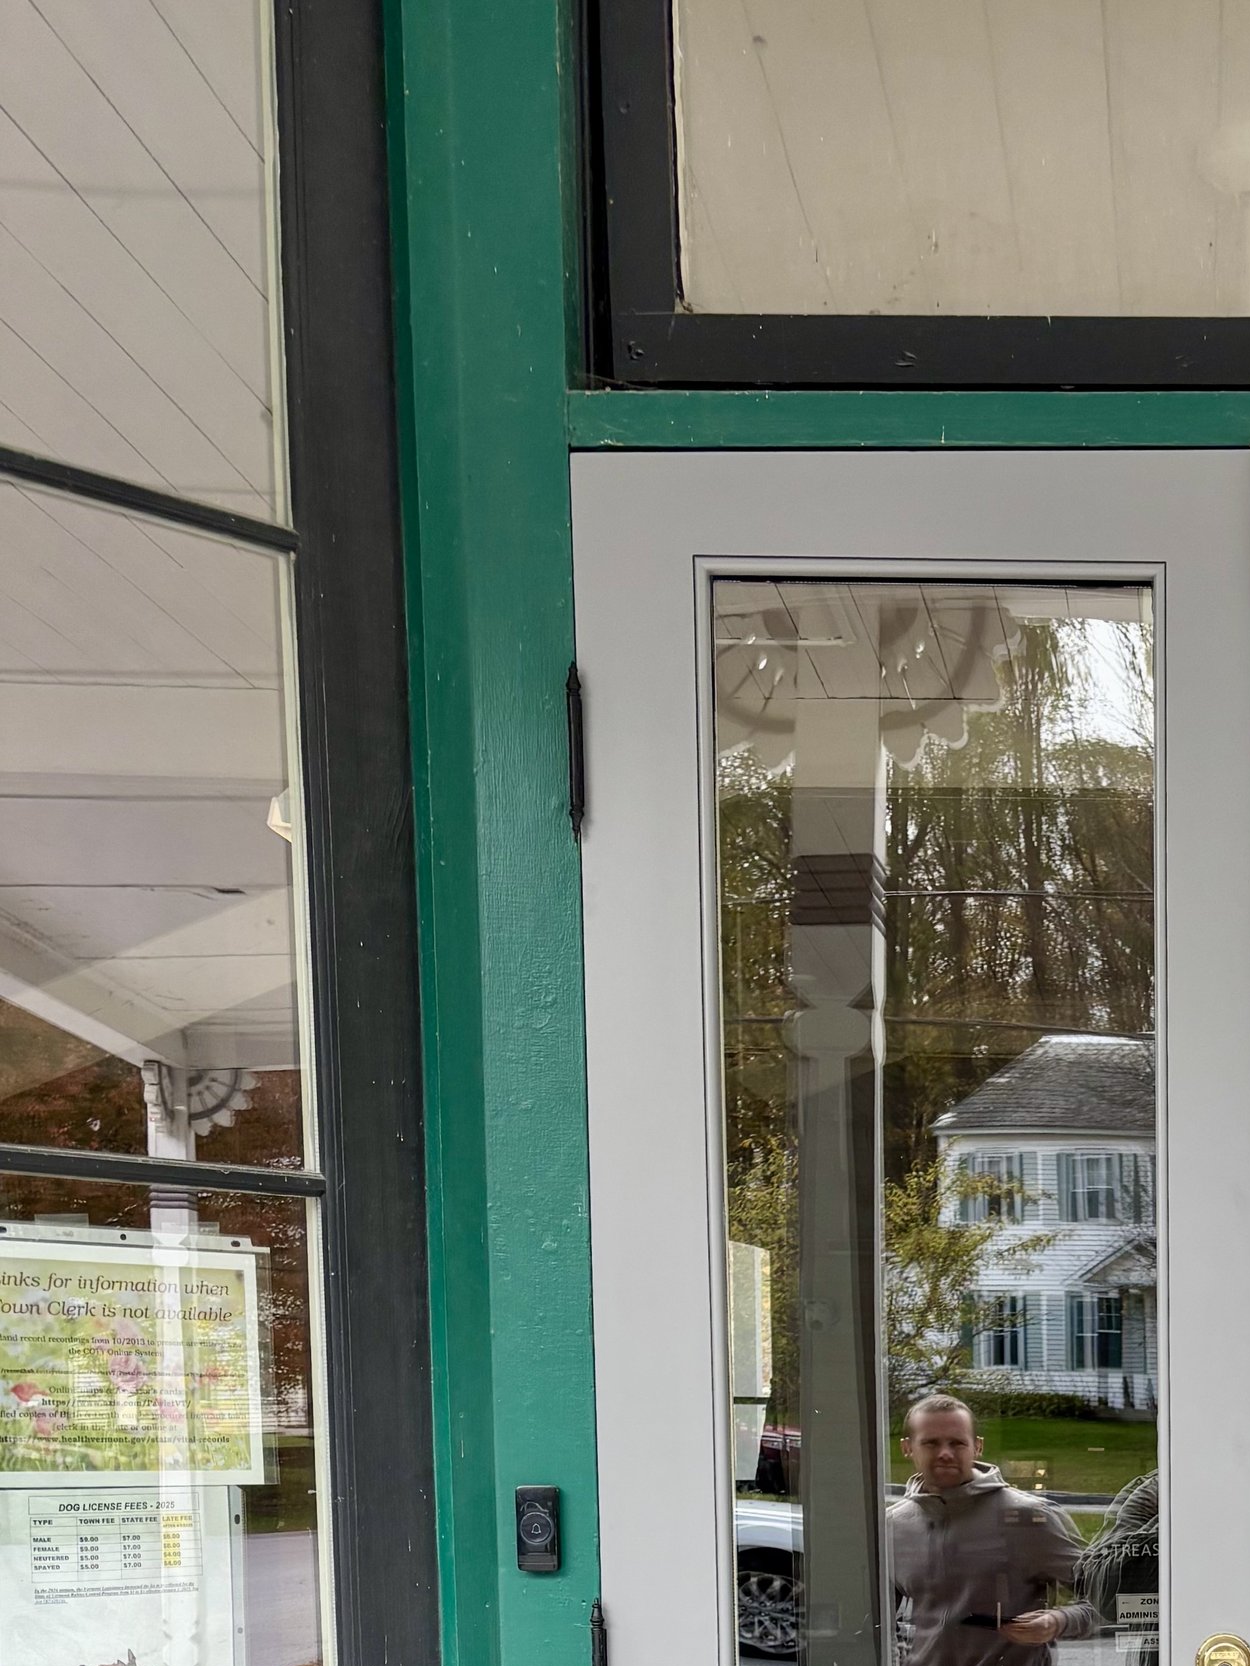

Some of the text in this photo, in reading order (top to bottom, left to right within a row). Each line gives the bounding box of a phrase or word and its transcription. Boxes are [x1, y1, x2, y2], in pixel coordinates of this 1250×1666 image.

[0, 1272, 230, 1296] inks for information when
[0, 1299, 233, 1323] own Clerk is not available
[91, 1336, 110, 1345] from
[112, 1337, 146, 1347] 10/2013
[147, 1339, 155, 1347] to
[68, 1347, 82, 1356] the
[19, 1410, 57, 1421] copies of
[58, 1503, 80, 1512] DOG
[82, 1502, 122, 1511] LICENSE
[124, 1501, 148, 1510] FEES
[155, 1501, 175, 1510] 2025
[121, 1516, 144, 1524] STATE
